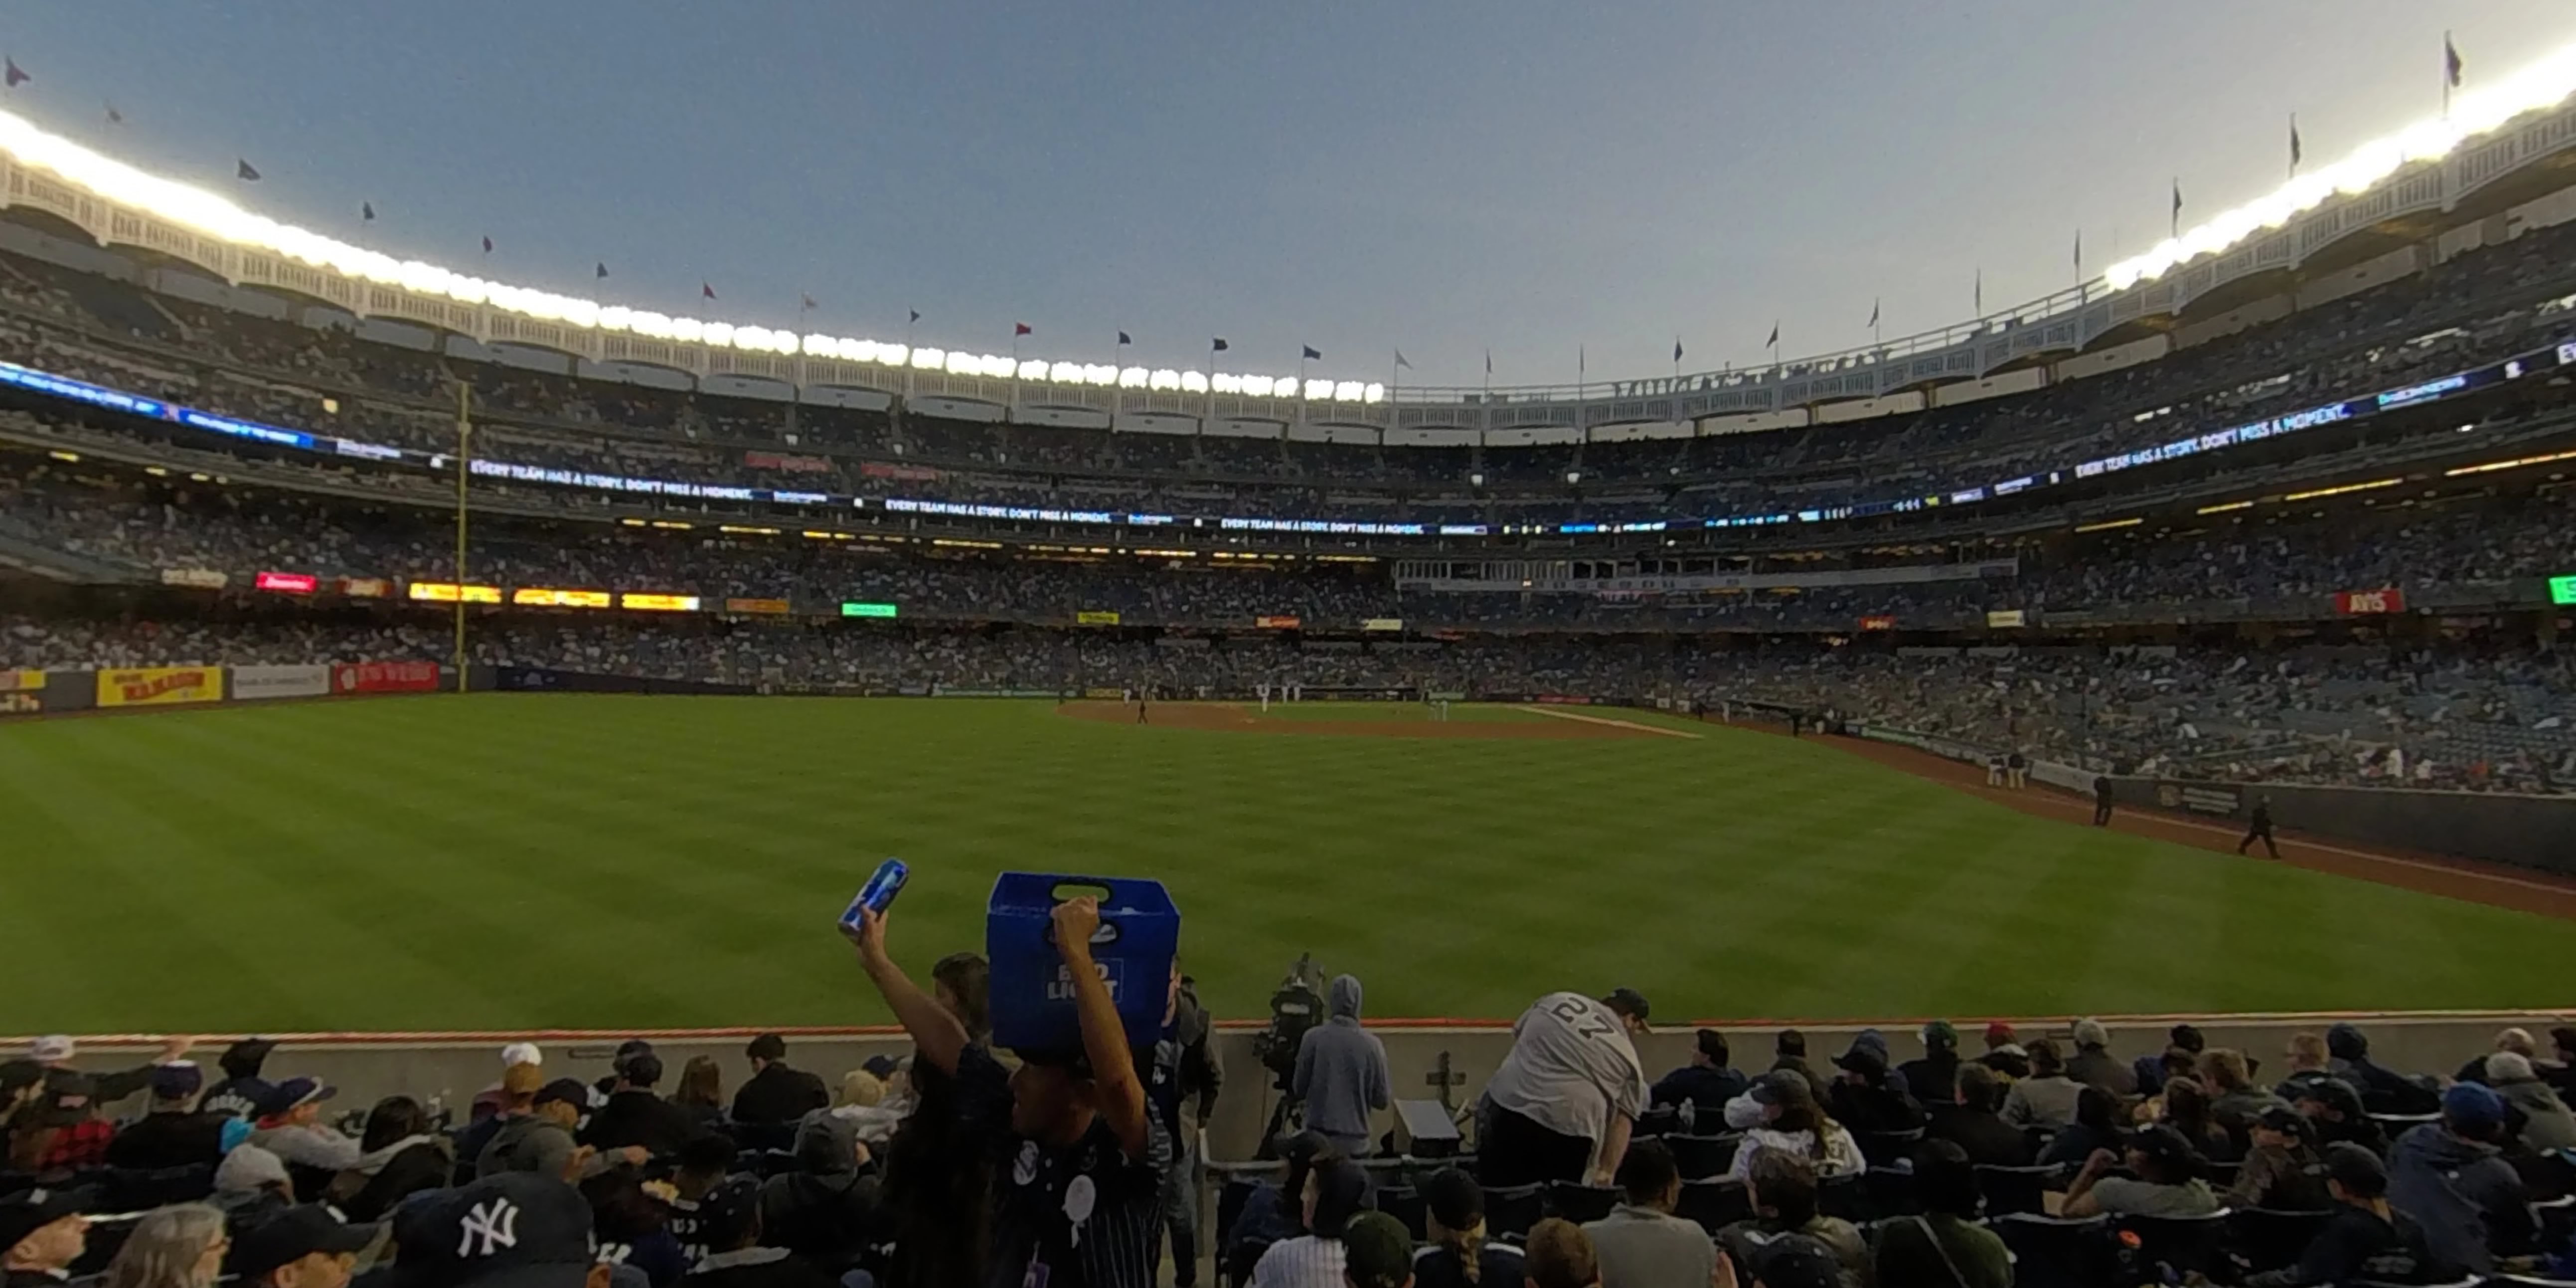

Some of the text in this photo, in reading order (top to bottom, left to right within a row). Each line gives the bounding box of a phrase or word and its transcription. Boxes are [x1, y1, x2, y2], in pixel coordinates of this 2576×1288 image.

[2075, 460, 2104, 479] EVERY
[2104, 454, 2131, 472] TEAM
[2154, 447, 2163, 462] A
[2271, 419, 2283, 435] A
[573, 473, 582, 486] A
[692, 485, 700, 496] A
[885, 499, 917, 511] EVERY
[920, 501, 946, 513] TEAM
[967, 504, 975, 515] A
[1062, 511, 1069, 521] A
[1293, 521, 1299, 531] A
[1378, 524, 1384, 533] A
[1058, 964, 1109, 981] BD
[1048, 979, 1118, 1000] LIT
[1552, 997, 1614, 1039] 27
[457, 1197, 518, 1258] NY
